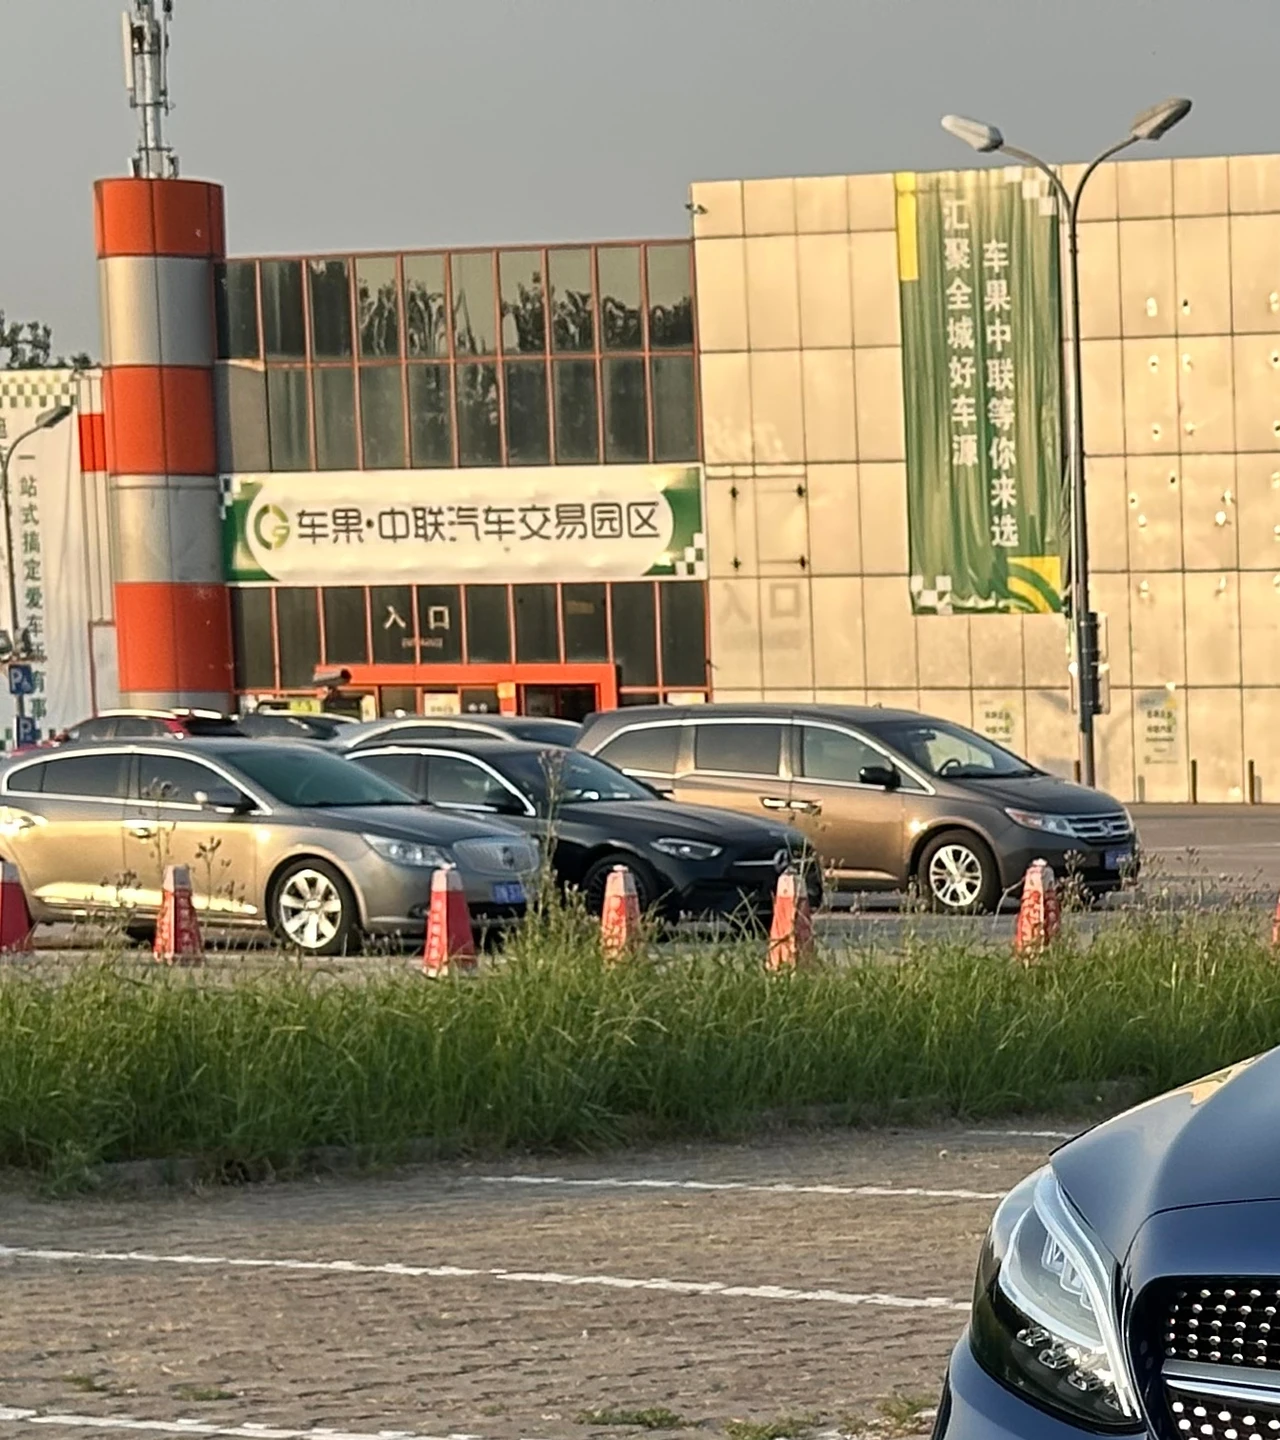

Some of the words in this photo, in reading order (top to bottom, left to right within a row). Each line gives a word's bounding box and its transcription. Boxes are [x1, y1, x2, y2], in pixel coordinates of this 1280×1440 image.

[943, 199, 978, 467] 汇聚全城好车源
[983, 238, 1019, 547] 车果中联等你来选
[297, 502, 660, 544] 车果·中联汽车交易园区
[384, 605, 449, 630] 入口
